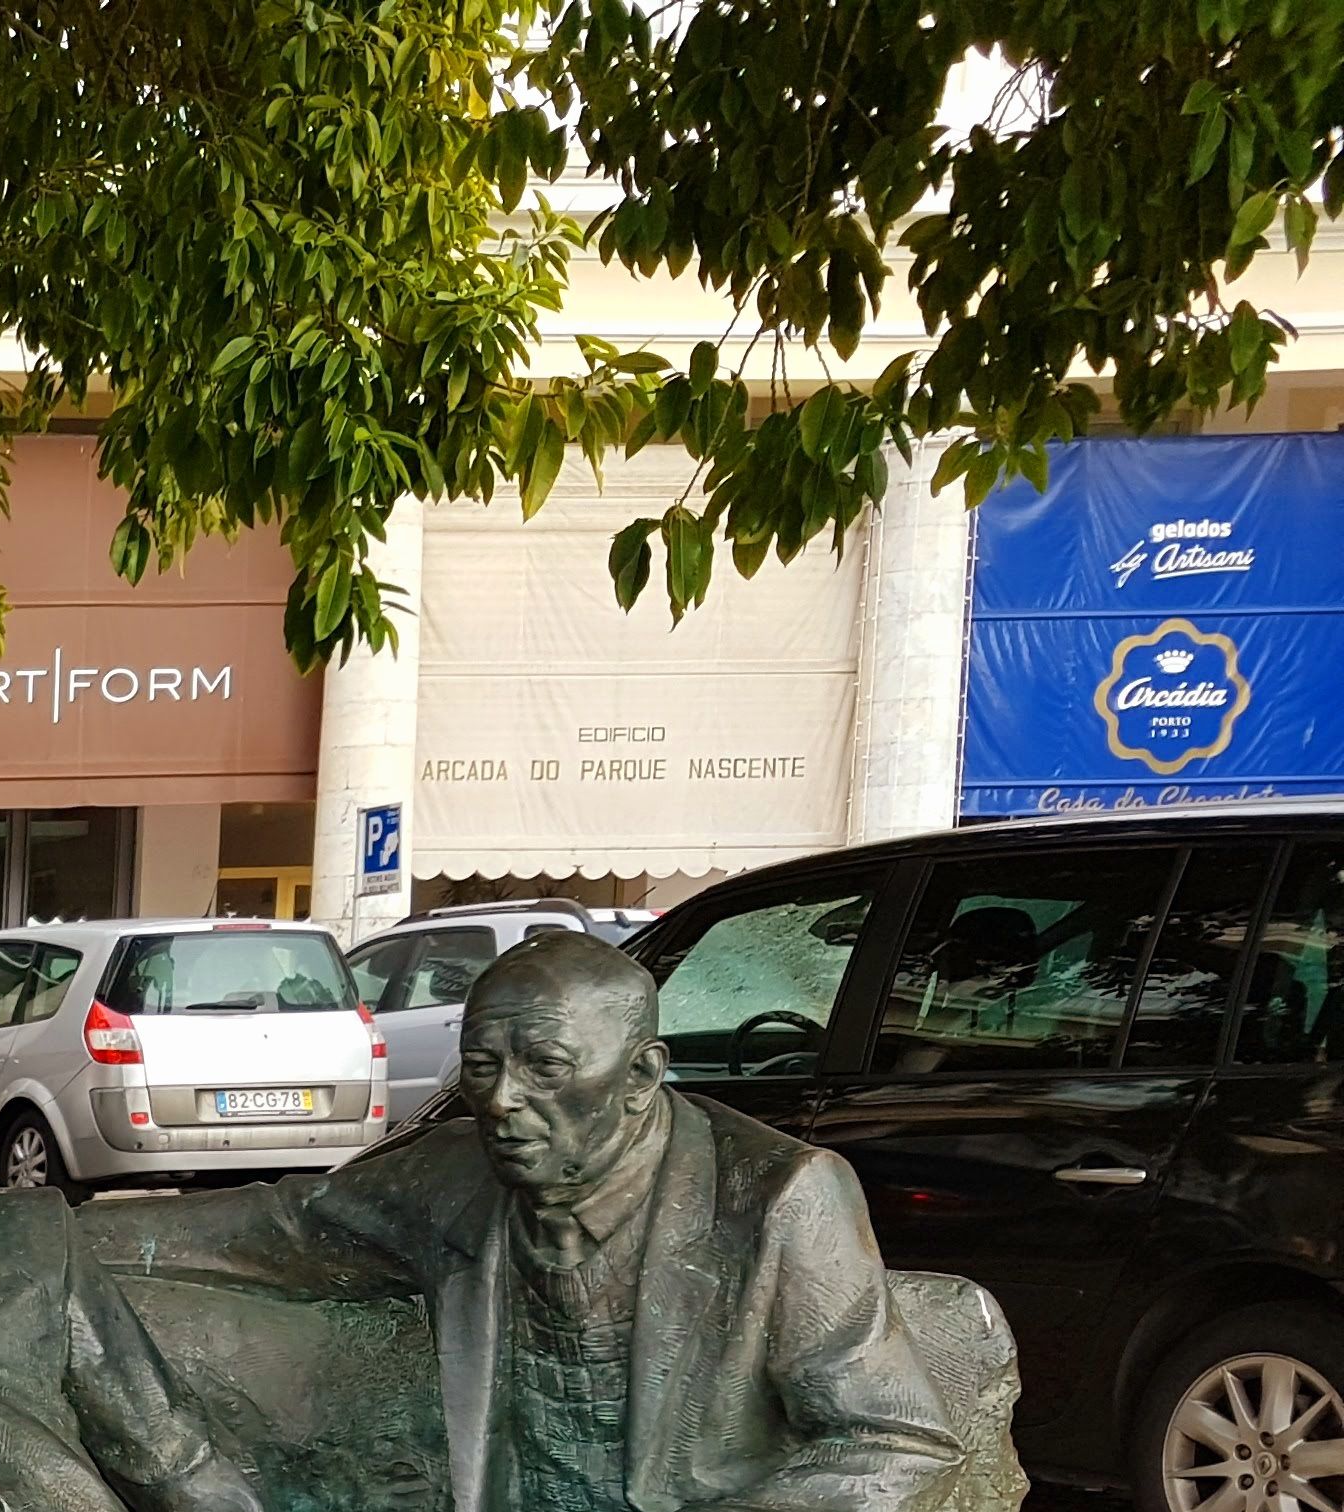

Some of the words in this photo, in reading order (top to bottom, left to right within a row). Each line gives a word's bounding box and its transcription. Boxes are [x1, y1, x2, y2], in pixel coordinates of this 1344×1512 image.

[1152, 519, 1232, 542] gelados
[1110, 540, 1148, 588] by
[1153, 543, 1254, 573] Artisani
[1117, 677, 1227, 711] Arcádia
[1152, 717, 1191, 727] PORTO
[578, 727, 666, 743] EDIFICIO
[421, 760, 509, 782] ARCADA
[530, 760, 560, 781] DO
[580, 759, 667, 782] PARQUE
[688, 757, 806, 780] NASCENTE
[1038, 788, 1105, 813] Casa
[368, 816, 383, 857] P
